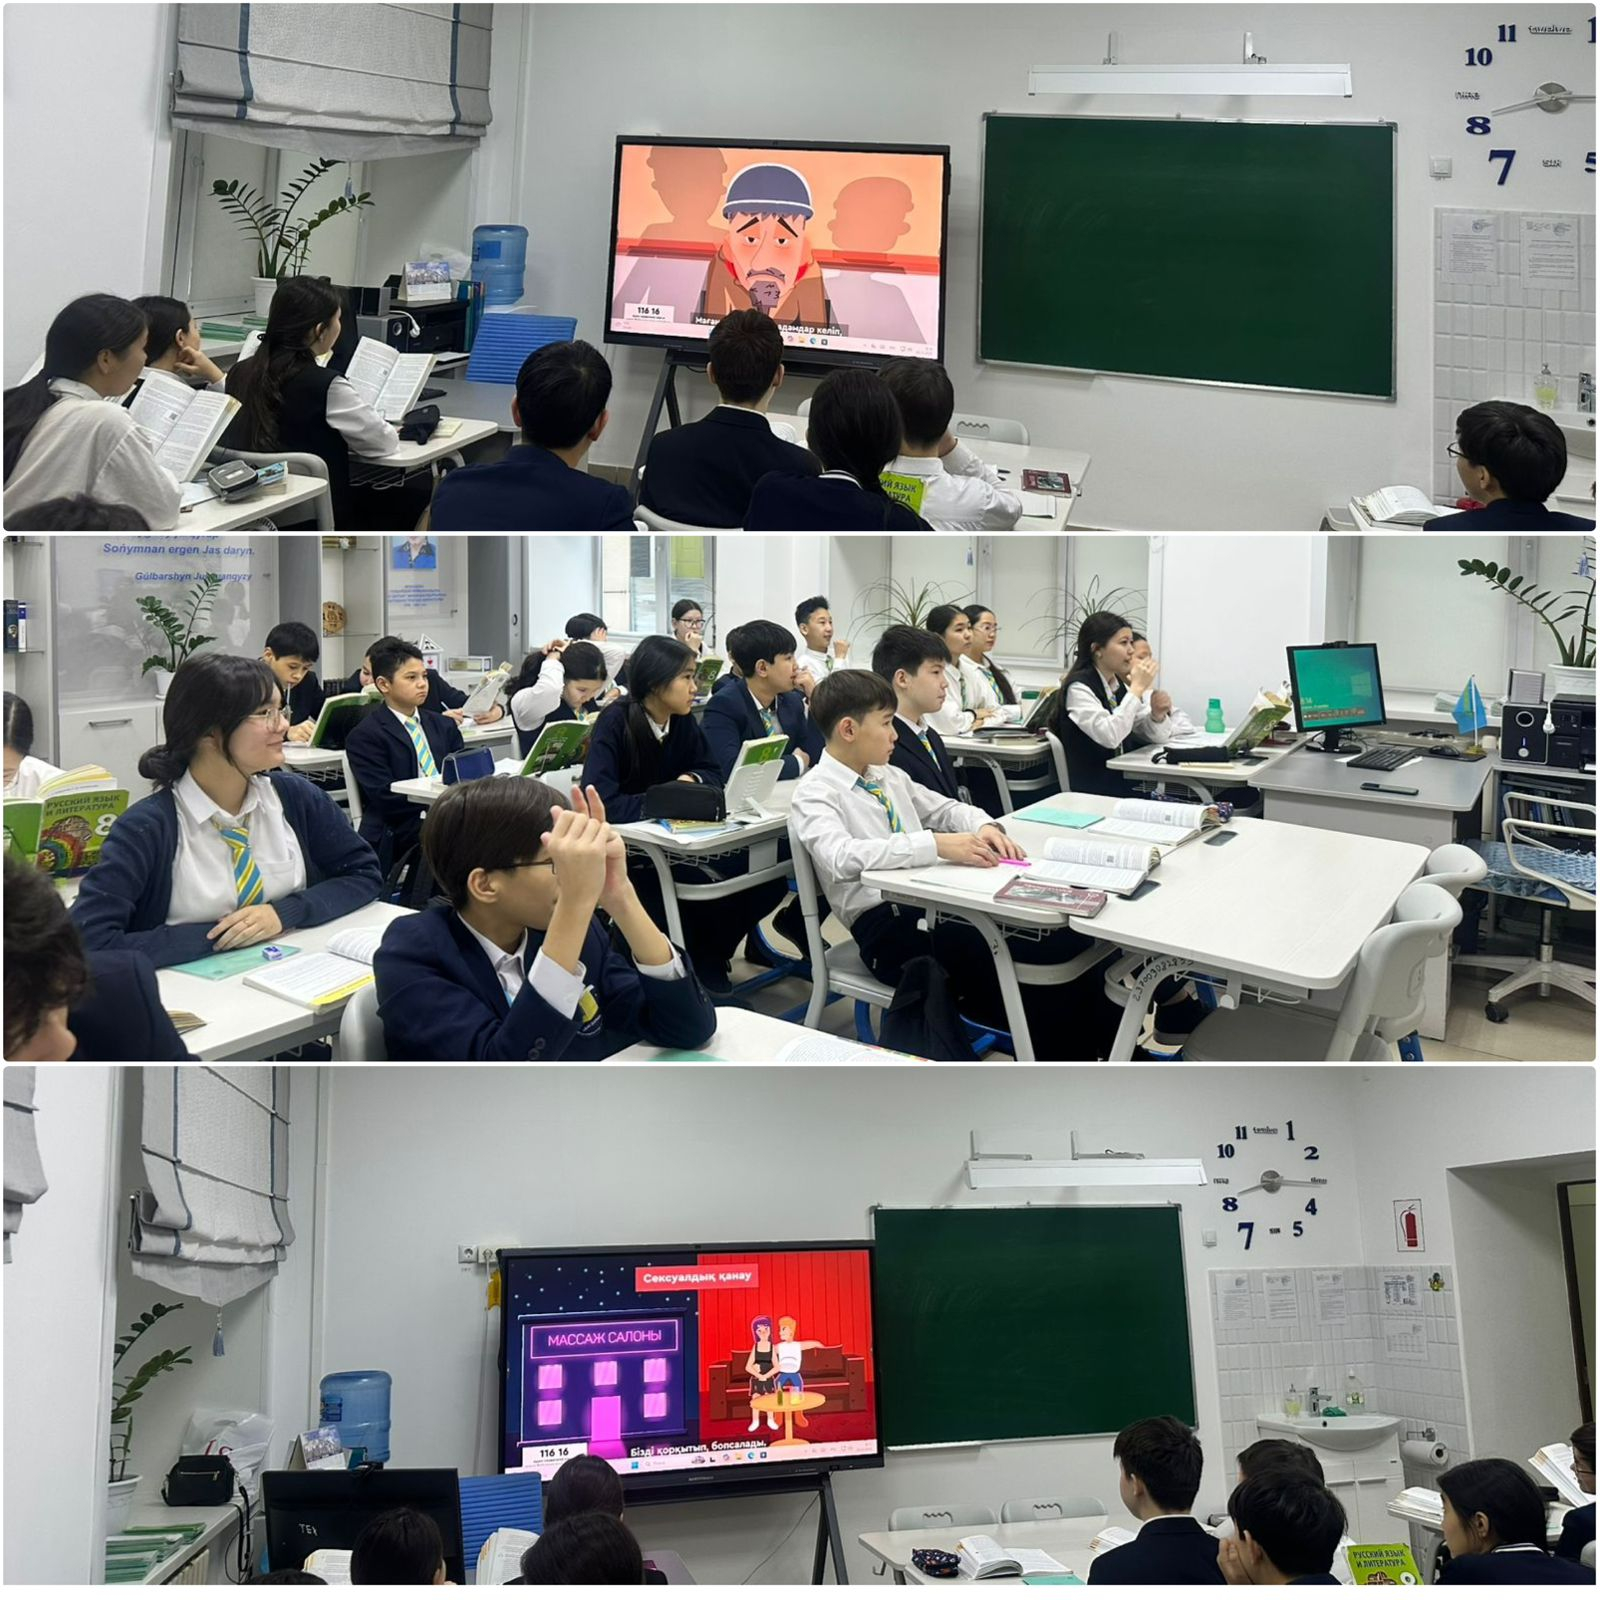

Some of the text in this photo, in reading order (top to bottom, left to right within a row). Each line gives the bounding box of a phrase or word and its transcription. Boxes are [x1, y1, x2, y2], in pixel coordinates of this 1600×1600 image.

[1498, 24, 1517, 42] 11
[1465, 47, 1493, 66] 10
[1466, 116, 1491, 135] 8
[1488, 149, 1517, 186] 7
[637, 306, 661, 316] 116 16
[168, 545, 199, 556] ergen
[202, 544, 221, 555] Jas
[707, 670, 717, 680] 8
[46, 794, 121, 809] РУССКИЙ ЯЗЫК
[54, 803, 115, 815] ЛИТЕРАТУРА
[94, 813, 119, 837] 8
[1235, 1125, 1248, 1140] 11
[1285, 1120, 1295, 1141] 1
[1217, 1143, 1236, 1159] 10
[1303, 1146, 1320, 1160] 2
[1222, 1196, 1239, 1212] 8
[1304, 1198, 1318, 1216] 4
[1237, 1221, 1255, 1250] 7
[1292, 1220, 1304, 1237] 5
[643, 1271, 752, 1284] Сексуалдық қанау
[547, 1329, 662, 1347] МАССАЖ САЛОНЫ
[540, 1447, 569, 1458] 116 16
[629, 1446, 655, 1458] Бізді
[1352, 1549, 1406, 1559] РУССКИЙ ЯЗЫК
[1363, 1559, 1406, 1568] ЛИТЕРАТУРА
